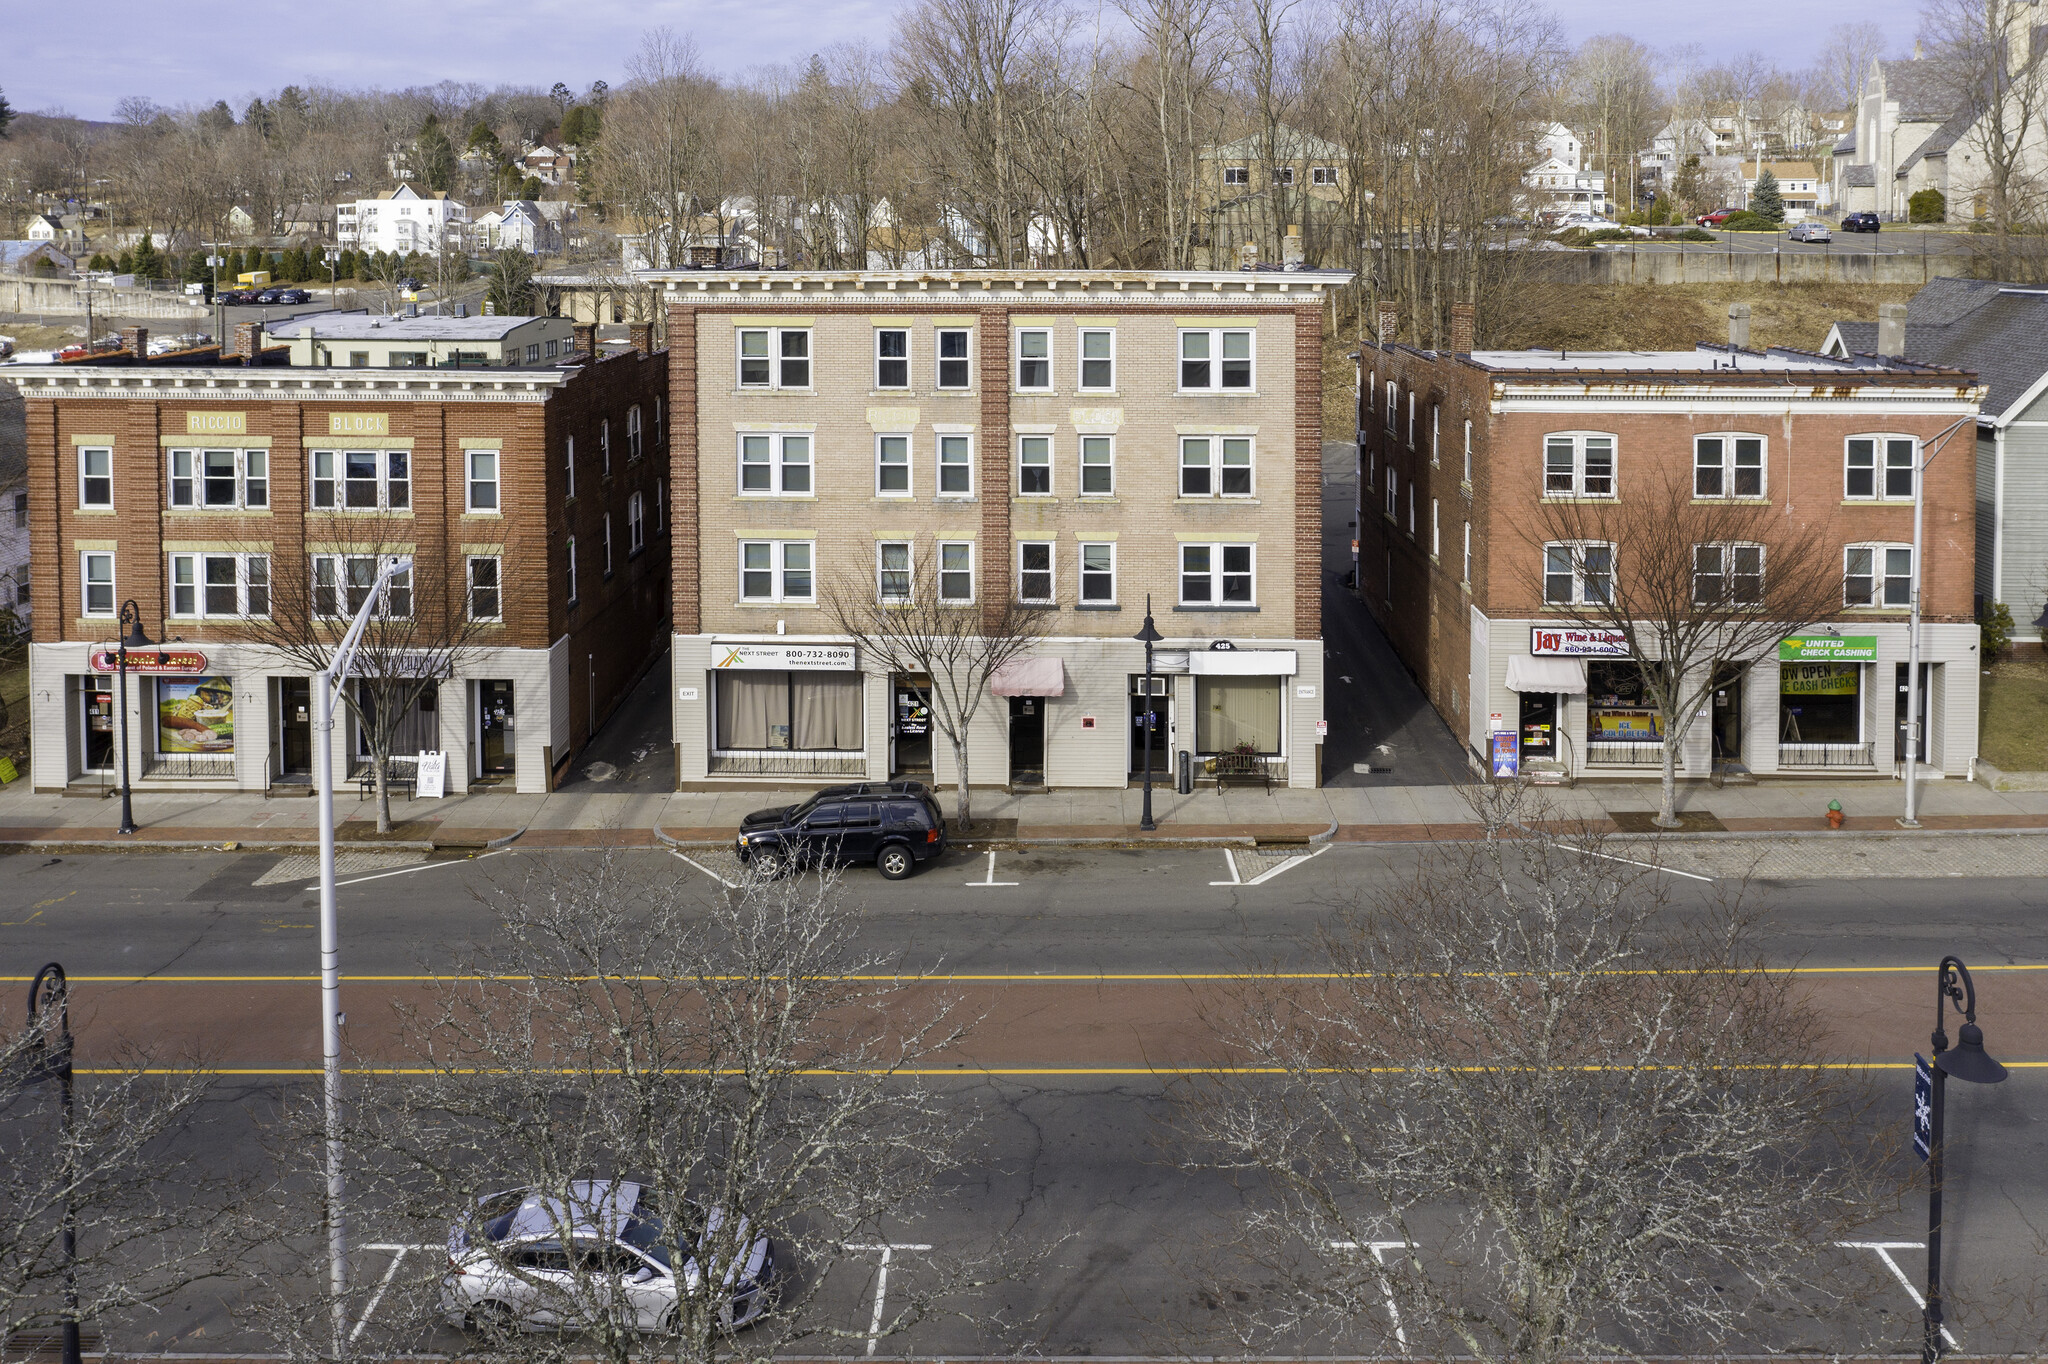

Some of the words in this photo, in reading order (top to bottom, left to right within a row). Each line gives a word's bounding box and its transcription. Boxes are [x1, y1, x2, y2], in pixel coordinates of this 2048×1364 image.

[190, 416, 242, 430] RICCIO
[333, 417, 385, 431] BLOCK
[1535, 631, 1562, 652] Jay
[1565, 632, 1588, 642] Wine
[1589, 632, 1597, 642] &
[1805, 640, 1845, 648] UNITED
[785, 650, 850, 659] 800-732-8090
[1833, 649, 1873, 657] CASHING
[163, 654, 198, 665] arket
[1780, 666, 1799, 680] OW
[1801, 665, 1831, 680] OPEN
[1792, 680, 1818, 692] CASH
[1821, 676, 1858, 690] CHECKS
[1618, 721, 1632, 730] ICE
[1603, 729, 1625, 738] COLD
[1626, 729, 1648, 738] BEER
